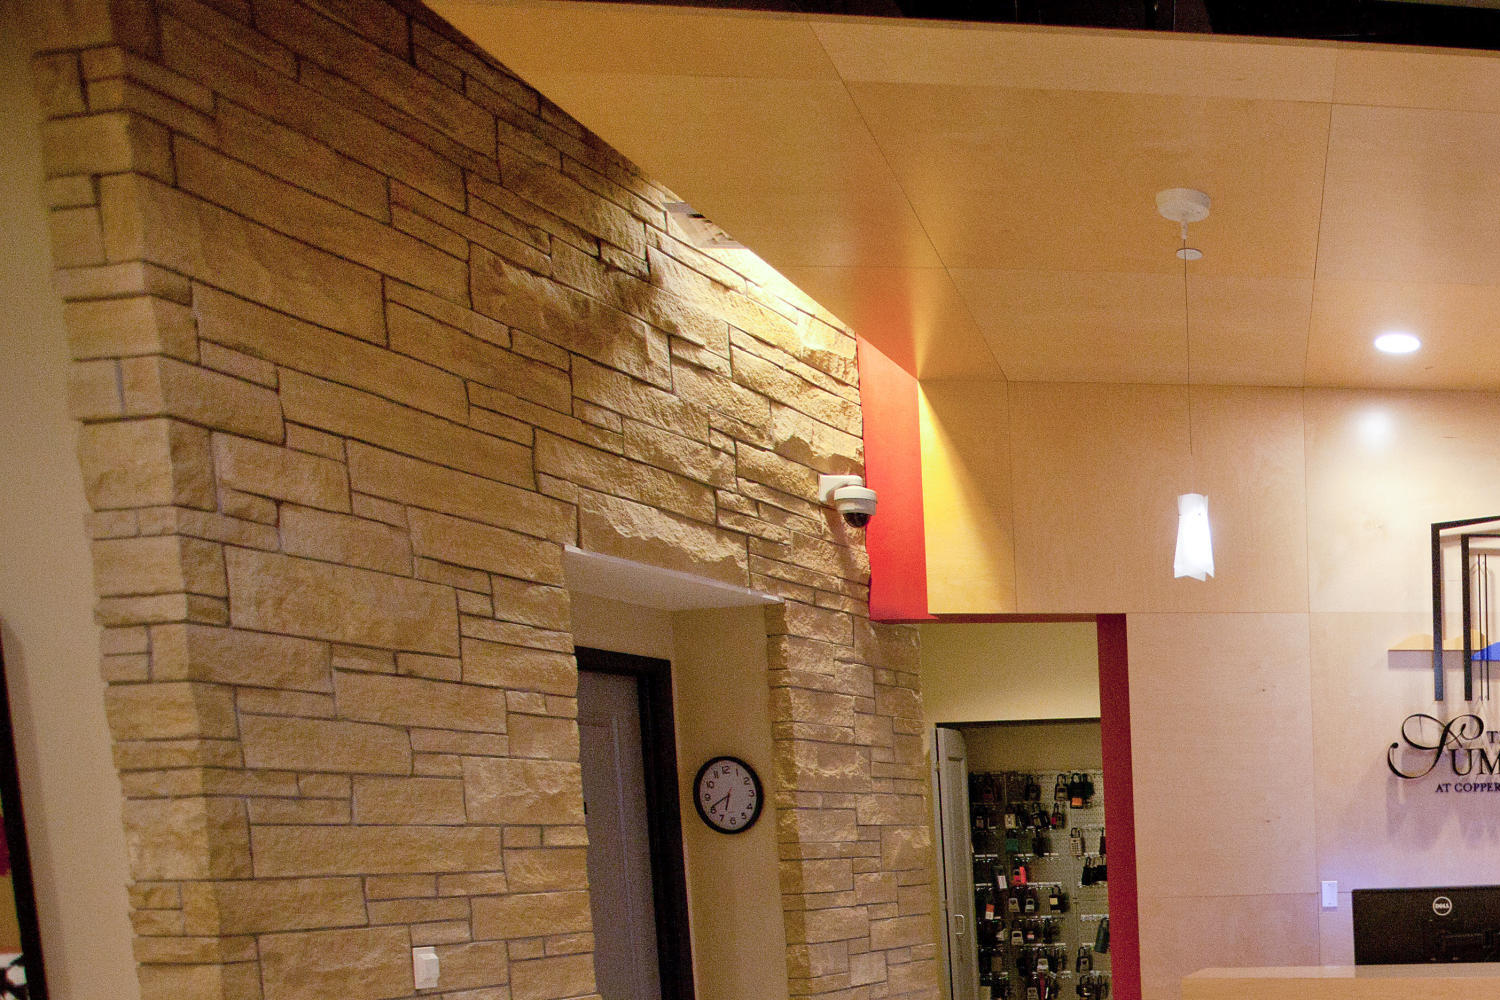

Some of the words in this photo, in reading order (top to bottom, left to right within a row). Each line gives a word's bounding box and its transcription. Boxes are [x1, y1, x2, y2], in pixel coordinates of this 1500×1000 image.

[721, 765, 730, 775] 12
[743, 777, 750, 786] 2
[1435, 782, 1451, 793] AT
[748, 789, 755, 798] 3
[719, 814, 725, 822] 7
[1435, 902, 1450, 910] DELL
